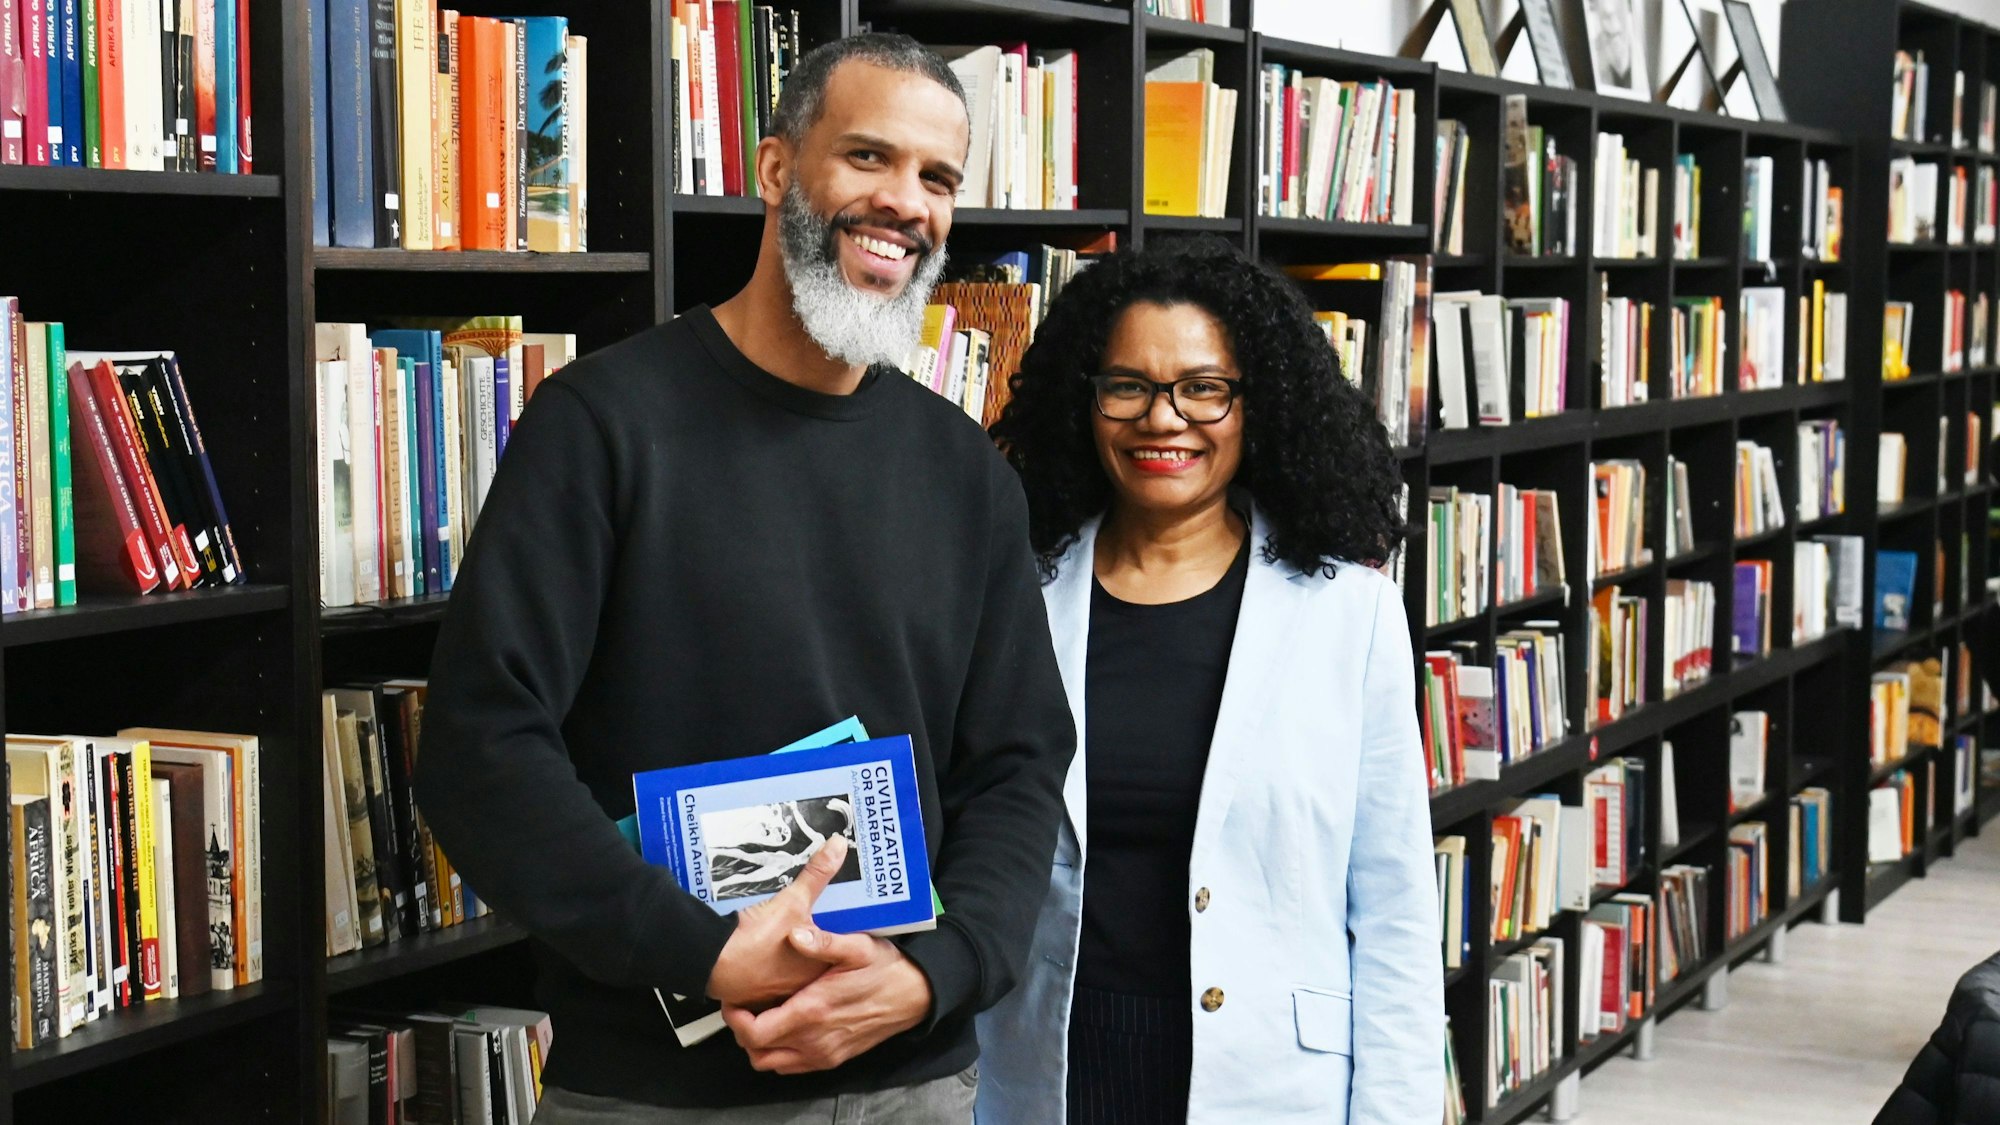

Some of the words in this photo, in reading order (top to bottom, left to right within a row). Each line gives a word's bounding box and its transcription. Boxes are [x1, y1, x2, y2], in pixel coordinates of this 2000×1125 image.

[3, 12, 12, 56] AFRIKA
[32, 14, 40, 58] AFRIKA
[47, 15, 56, 58] AFRIKA
[66, 18, 74, 60] AFRIKA
[413, 17, 424, 52] IFE
[517, 27, 525, 105] verschleierte
[517, 107, 525, 130] Der
[8, 144, 16, 161] prv
[13, 362, 19, 372] OF
[17, 464, 22, 478] AD
[0, 413, 11, 513] AFRICA
[87, 396, 96, 410] THE
[93, 413, 108, 446] AFRICAN
[106, 446, 118, 473] ORIGIN
[116, 474, 122, 484] OF
[120, 486, 138, 529] CIVILIZATIO
[110, 396, 119, 413] THE
[117, 414, 131, 446] AFRICAN
[128, 447, 141, 473] ORIGIN
[138, 474, 145, 484] OF
[143, 486, 163, 534] CIVILIZATION
[851, 770, 858, 783] An
[861, 768, 872, 791] OR
[853, 785, 863, 832] Authentic
[875, 766, 904, 895] CIVILIZATION
[28, 826, 41, 901] AFRICA
[63, 835, 73, 876] Wunder
[90, 813, 101, 900] IMHOTEP
[684, 794, 698, 846] Cheikh
[692, 849, 703, 886] Anta
[865, 796, 887, 897] BARBARISM
[858, 834, 874, 898] Anthropology
[66, 879, 75, 910] voller
[67, 932, 78, 964] Afrika
[36, 957, 44, 1012] MEREDITH
